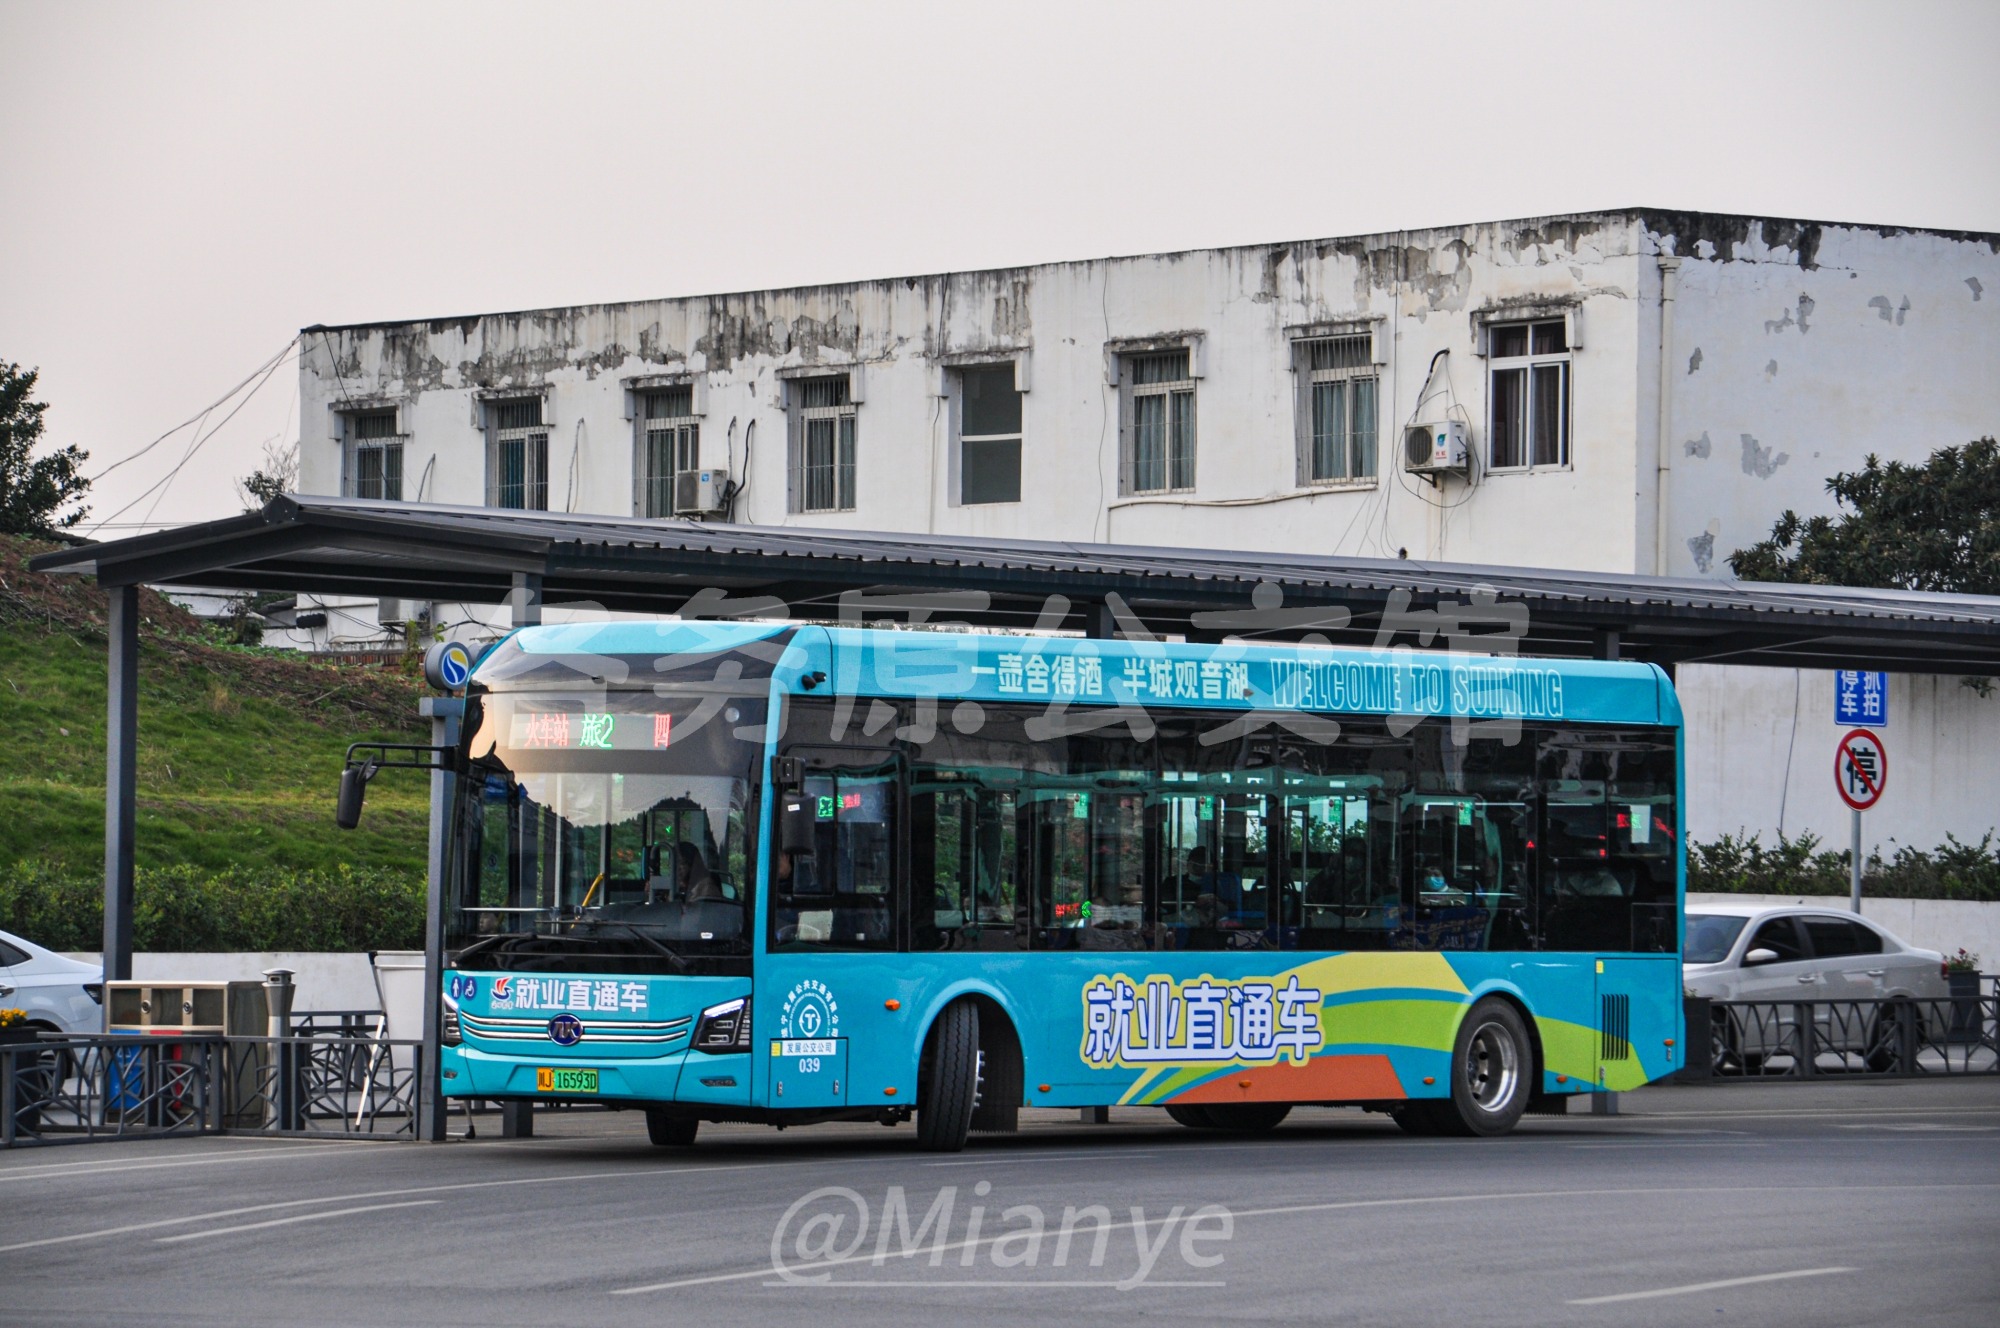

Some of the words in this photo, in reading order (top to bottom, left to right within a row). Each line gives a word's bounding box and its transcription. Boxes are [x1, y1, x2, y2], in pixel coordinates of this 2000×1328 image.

[972, 653, 1103, 696] 一壶舍得酒
[1123, 657, 1250, 702] 半城观音湖
[1270, 658, 1402, 713] WELCOME
[1410, 664, 1444, 713] TO
[1452, 664, 1564, 718] SUINING
[524, 712, 571, 748] 火车站
[578, 711, 616, 750] 旅2
[1845, 747, 1878, 795] 停
[515, 977, 648, 1013] 就业直通车
[1083, 974, 1324, 1063] 就业直通车
[787, 1042, 832, 1054] 发展公交公司
[798, 1057, 821, 1074] 039
